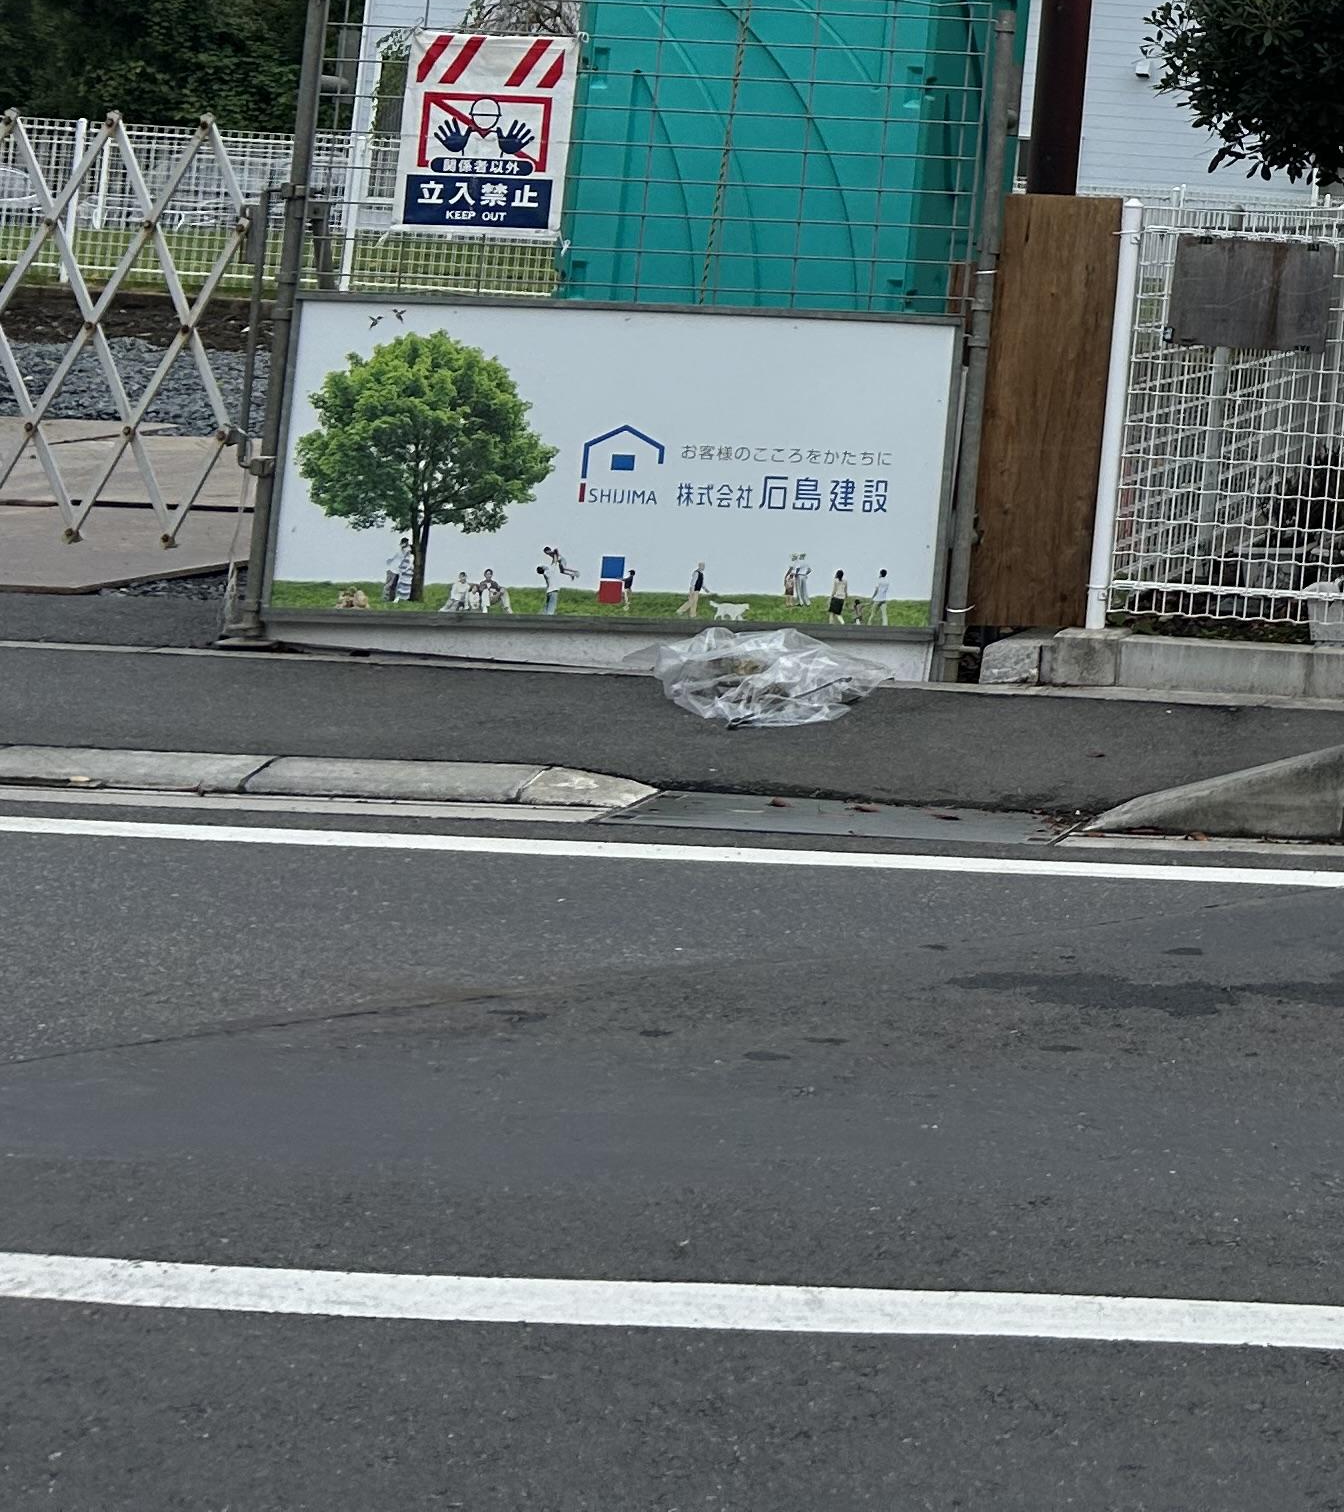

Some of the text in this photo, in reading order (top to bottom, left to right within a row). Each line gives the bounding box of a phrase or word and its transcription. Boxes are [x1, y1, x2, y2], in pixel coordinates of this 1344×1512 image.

[442, 158, 520, 175] 関係者以外
[417, 180, 539, 208] 立入禁止
[445, 210, 507, 222] KEEP OUT
[681, 444, 893, 467] お客様のこころをかたちに
[578, 482, 658, 506] ISHIJIMA
